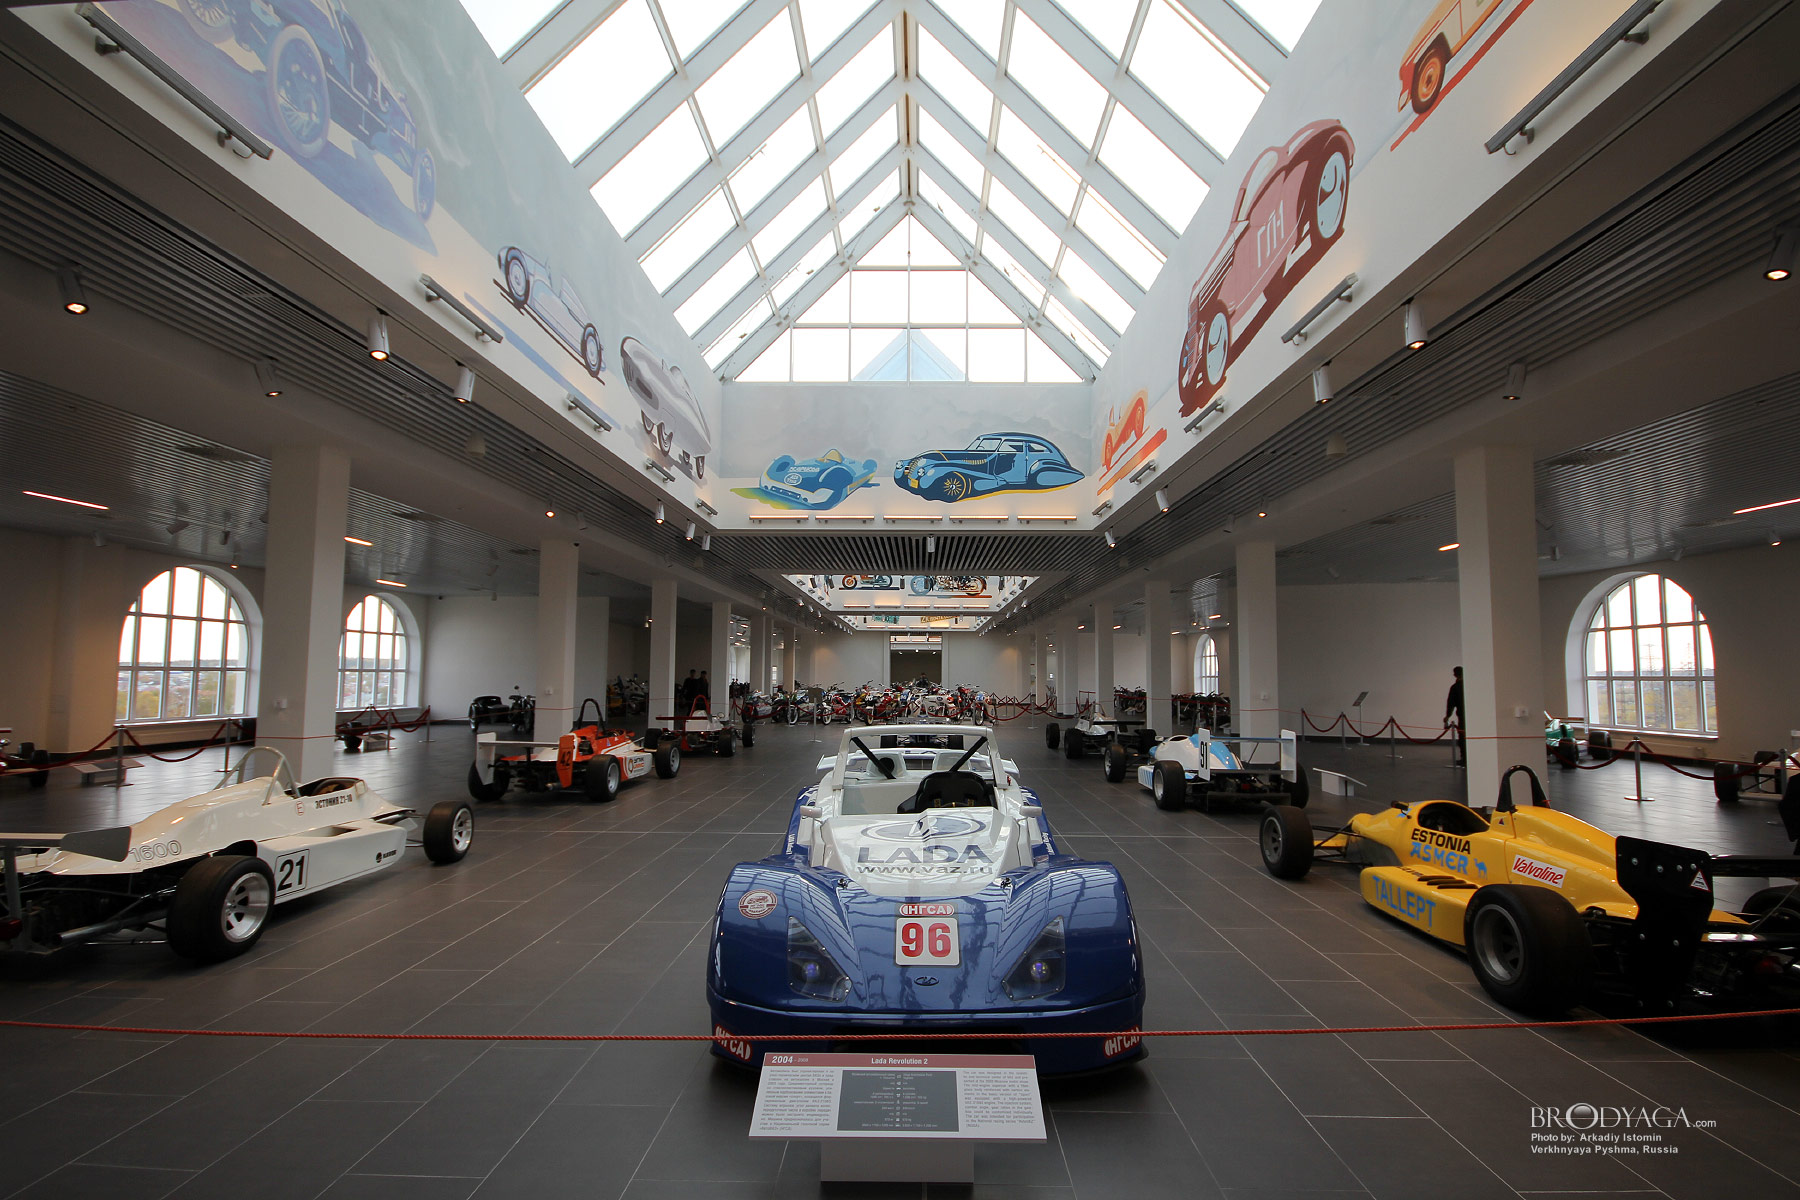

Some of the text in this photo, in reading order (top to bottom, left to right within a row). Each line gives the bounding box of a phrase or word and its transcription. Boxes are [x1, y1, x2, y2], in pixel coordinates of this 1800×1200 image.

[1201, 741, 1208, 770] 91
[128, 840, 182, 862] 1600
[857, 845, 994, 864] LADA
[1411, 829, 1471, 854] ESTONIA
[857, 866, 993, 875] www.vaz.ru
[1410, 842, 1469, 875] ASMER
[1513, 857, 1564, 885] Valvoline
[277, 856, 305, 891] 21
[1372, 875, 1436, 928] TALLEPT
[901, 922, 951, 957] 96
[771, 1055, 793, 1064] 2004
